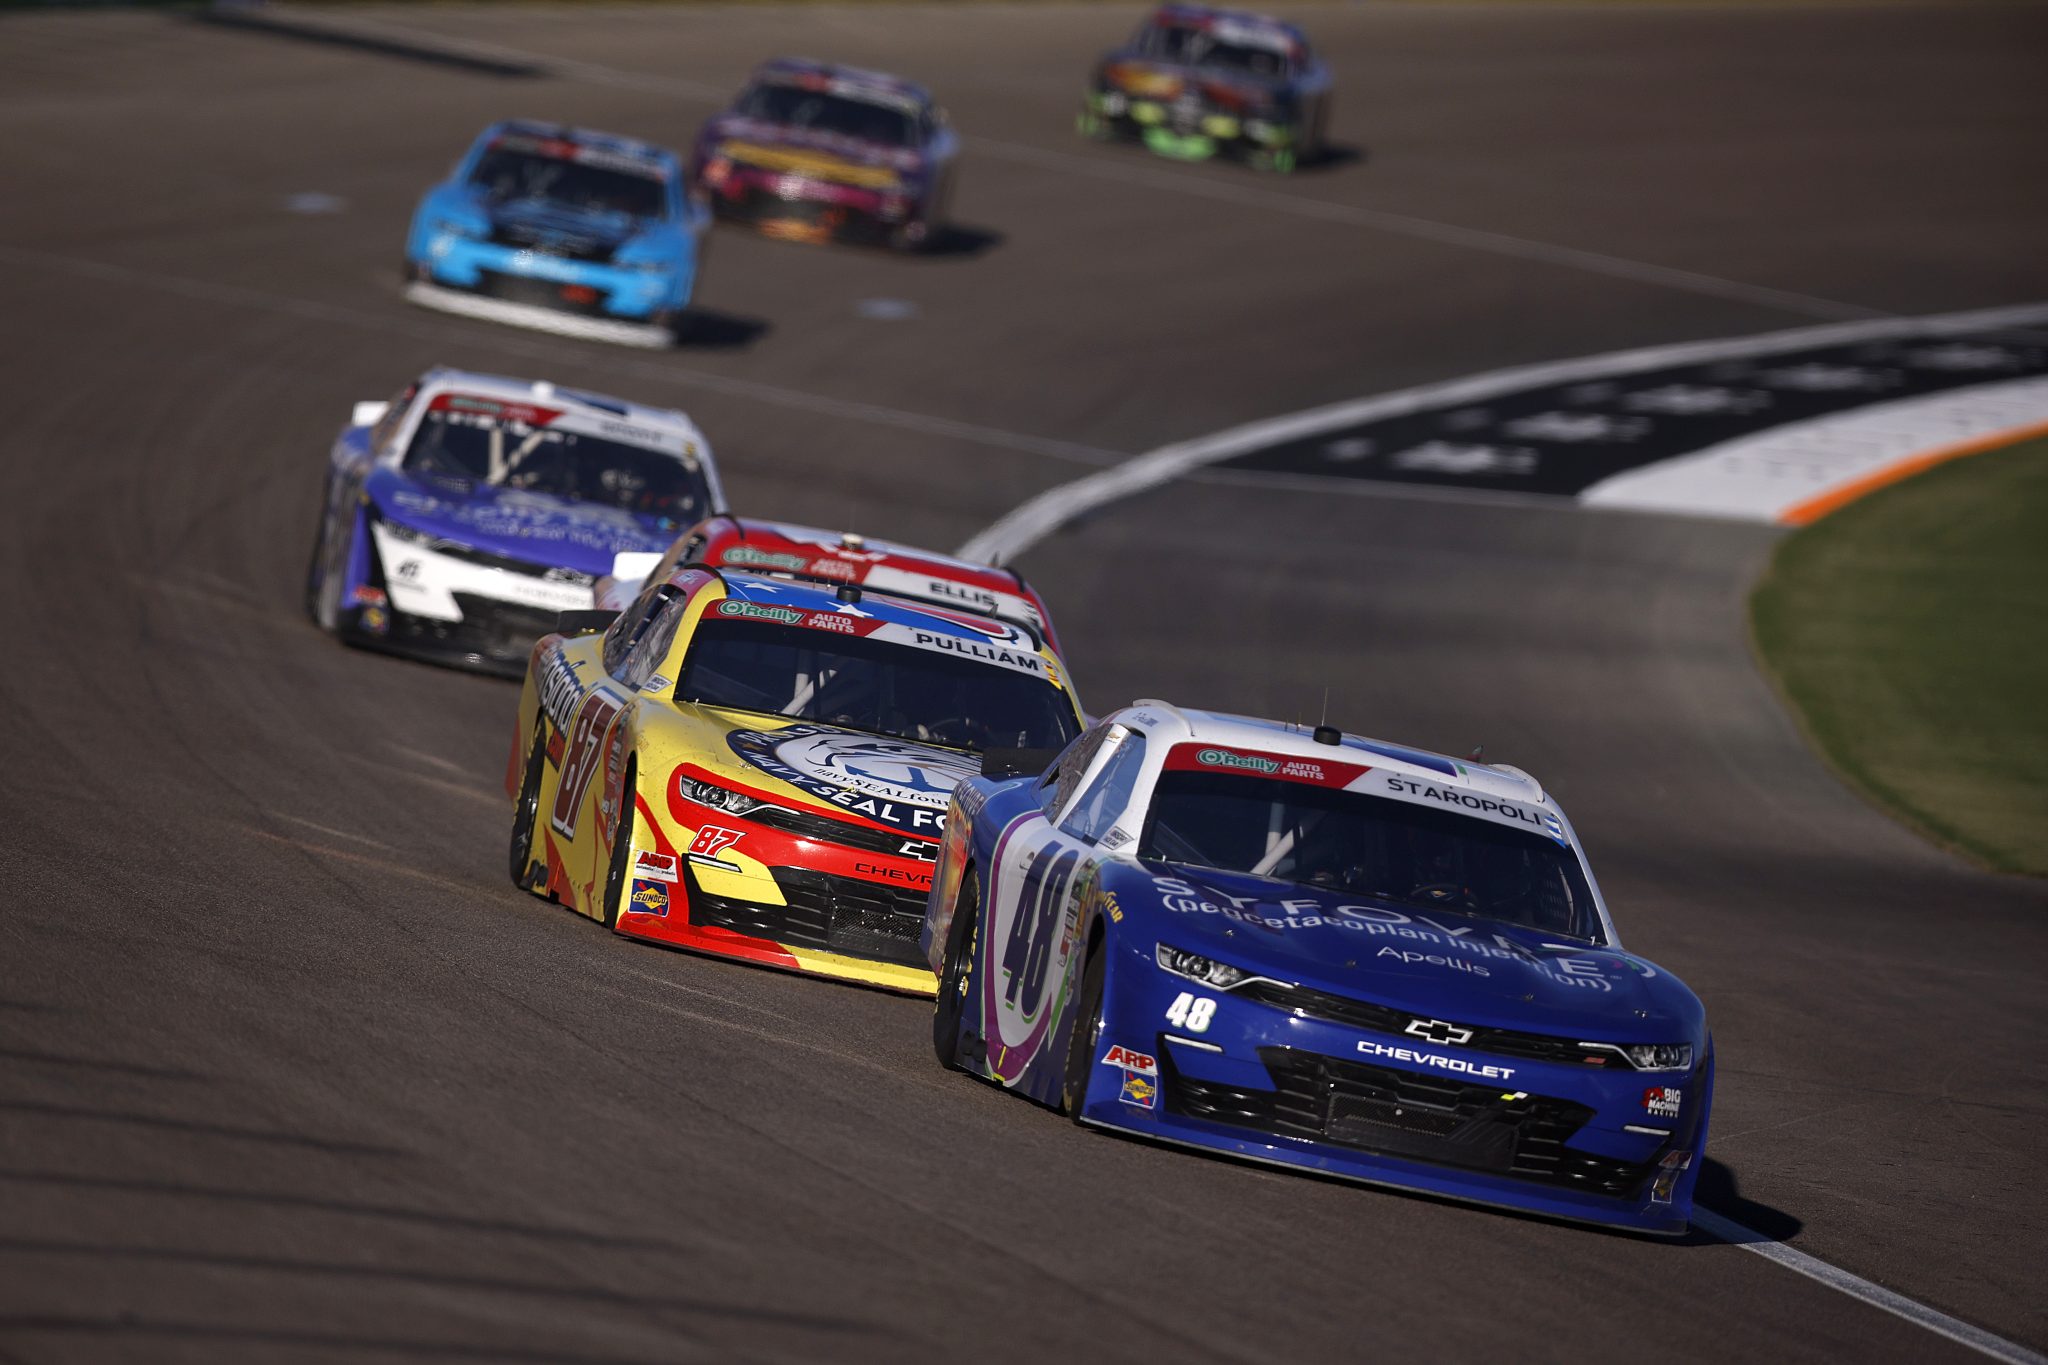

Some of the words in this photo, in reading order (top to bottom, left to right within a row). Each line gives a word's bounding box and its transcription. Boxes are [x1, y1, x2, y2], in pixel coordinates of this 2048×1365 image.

[722, 547, 807, 571] O'Reilly
[930, 582, 996, 606] ELLIS
[718, 600, 805, 625] O'Reilly
[815, 613, 852, 626] AUTO
[808, 618, 855, 634] PARTS
[915, 633, 1039, 671] PULLIAM
[552, 688, 628, 843] 87
[1196, 749, 1282, 775] O'Reilly
[1282, 767, 1325, 781] PARTS
[1286, 761, 1321, 773] AUTO
[811, 786, 901, 823] SEAL
[1387, 778, 1542, 826] STAROPOLI
[688, 824, 748, 860] 87
[636, 851, 674, 870] ARP
[633, 891, 668, 905] SUNOCO
[1003, 840, 1079, 1017] 48
[1377, 946, 1491, 978] Apellis
[1165, 991, 1217, 1033] 48
[1105, 1046, 1155, 1070] ARP
[1357, 1040, 1516, 1080] CHEVROLET
[1647, 1099, 1680, 1112] MACHINE
[1663, 1087, 1681, 1103] BIG
